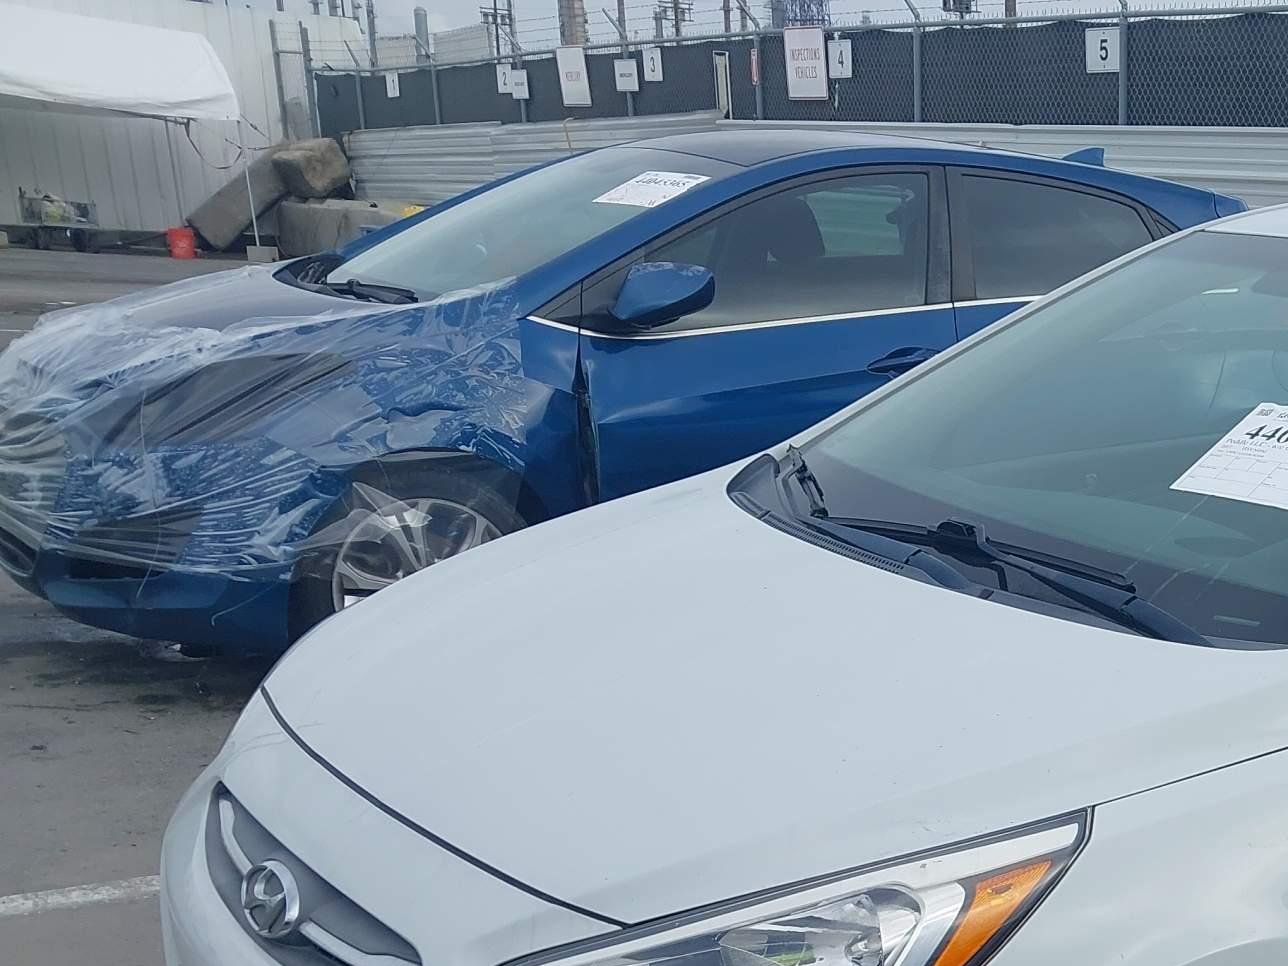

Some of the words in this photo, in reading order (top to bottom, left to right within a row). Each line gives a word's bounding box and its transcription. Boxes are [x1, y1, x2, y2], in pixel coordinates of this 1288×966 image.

[791, 47, 821, 61] INSPECTIONS
[1099, 38, 1109, 61] 5
[650, 56, 656, 73] 3
[837, 50, 844, 69] 4
[502, 71, 508, 86] 2
